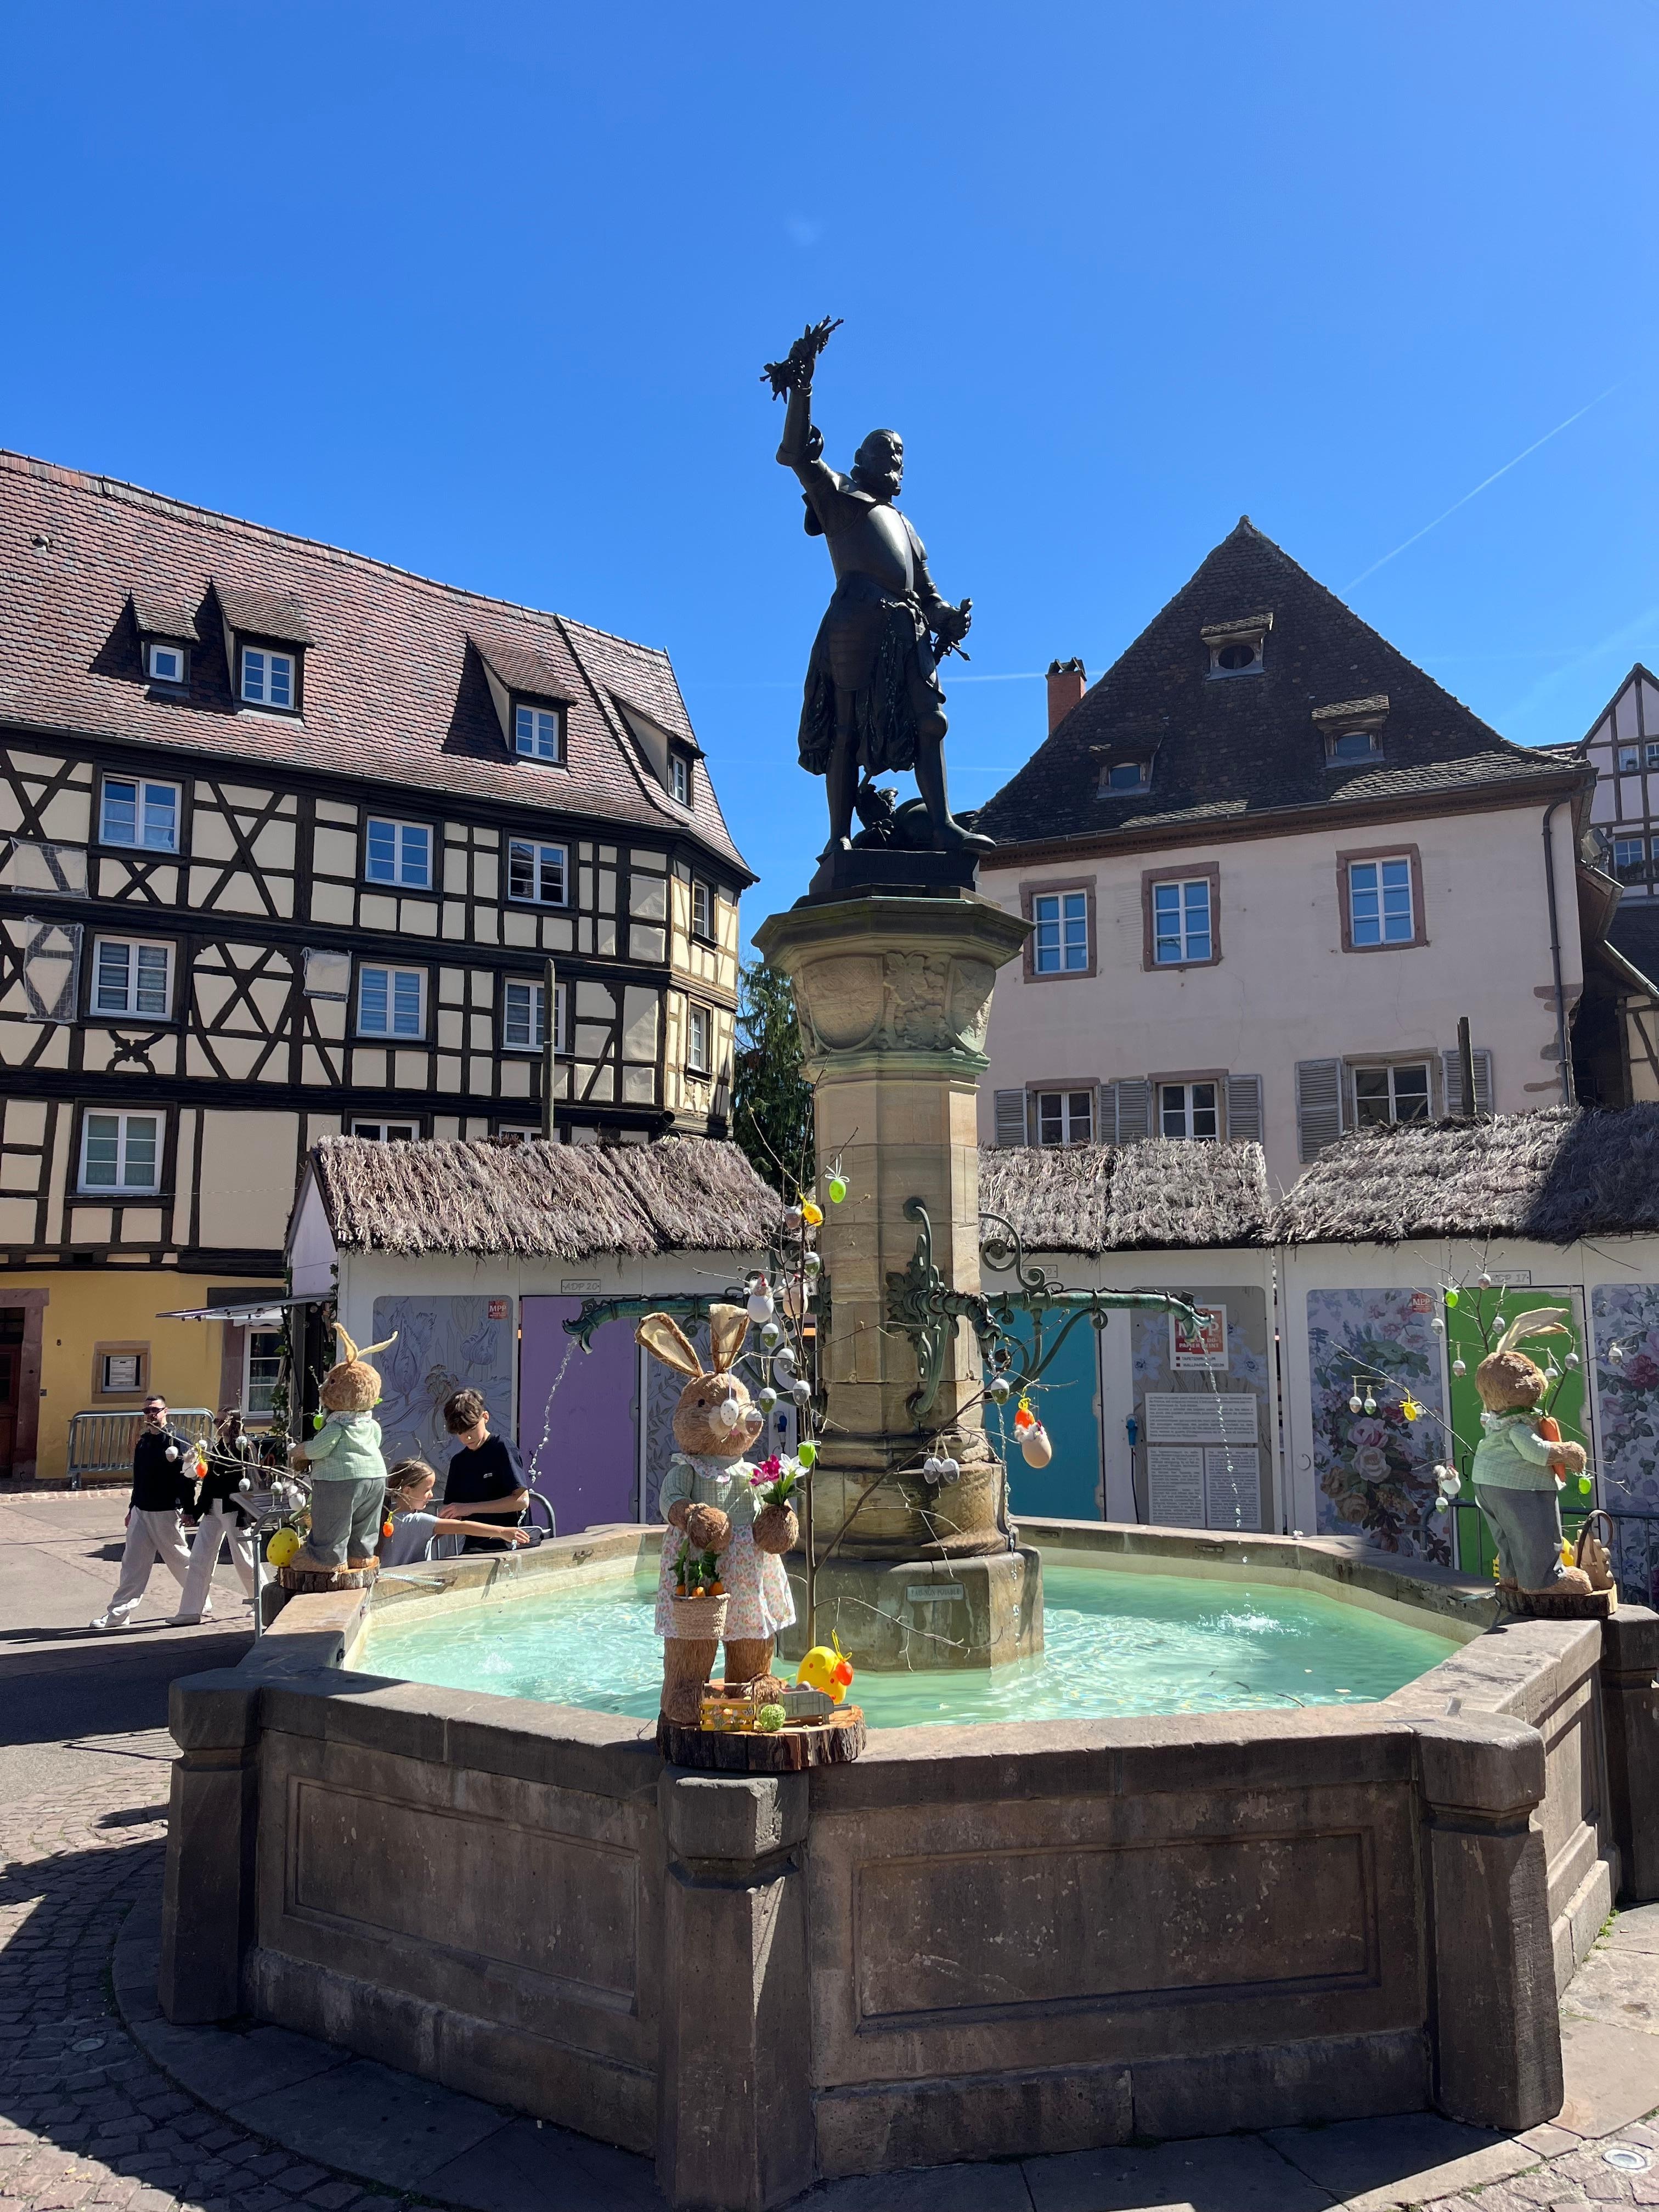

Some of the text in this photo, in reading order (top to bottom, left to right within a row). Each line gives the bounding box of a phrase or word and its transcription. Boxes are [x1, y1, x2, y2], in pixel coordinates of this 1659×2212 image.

[1516, 1274, 1527, 1282] 17
[924, 1588, 935, 1596] NON
[938, 1588, 960, 1596] POTABLE
